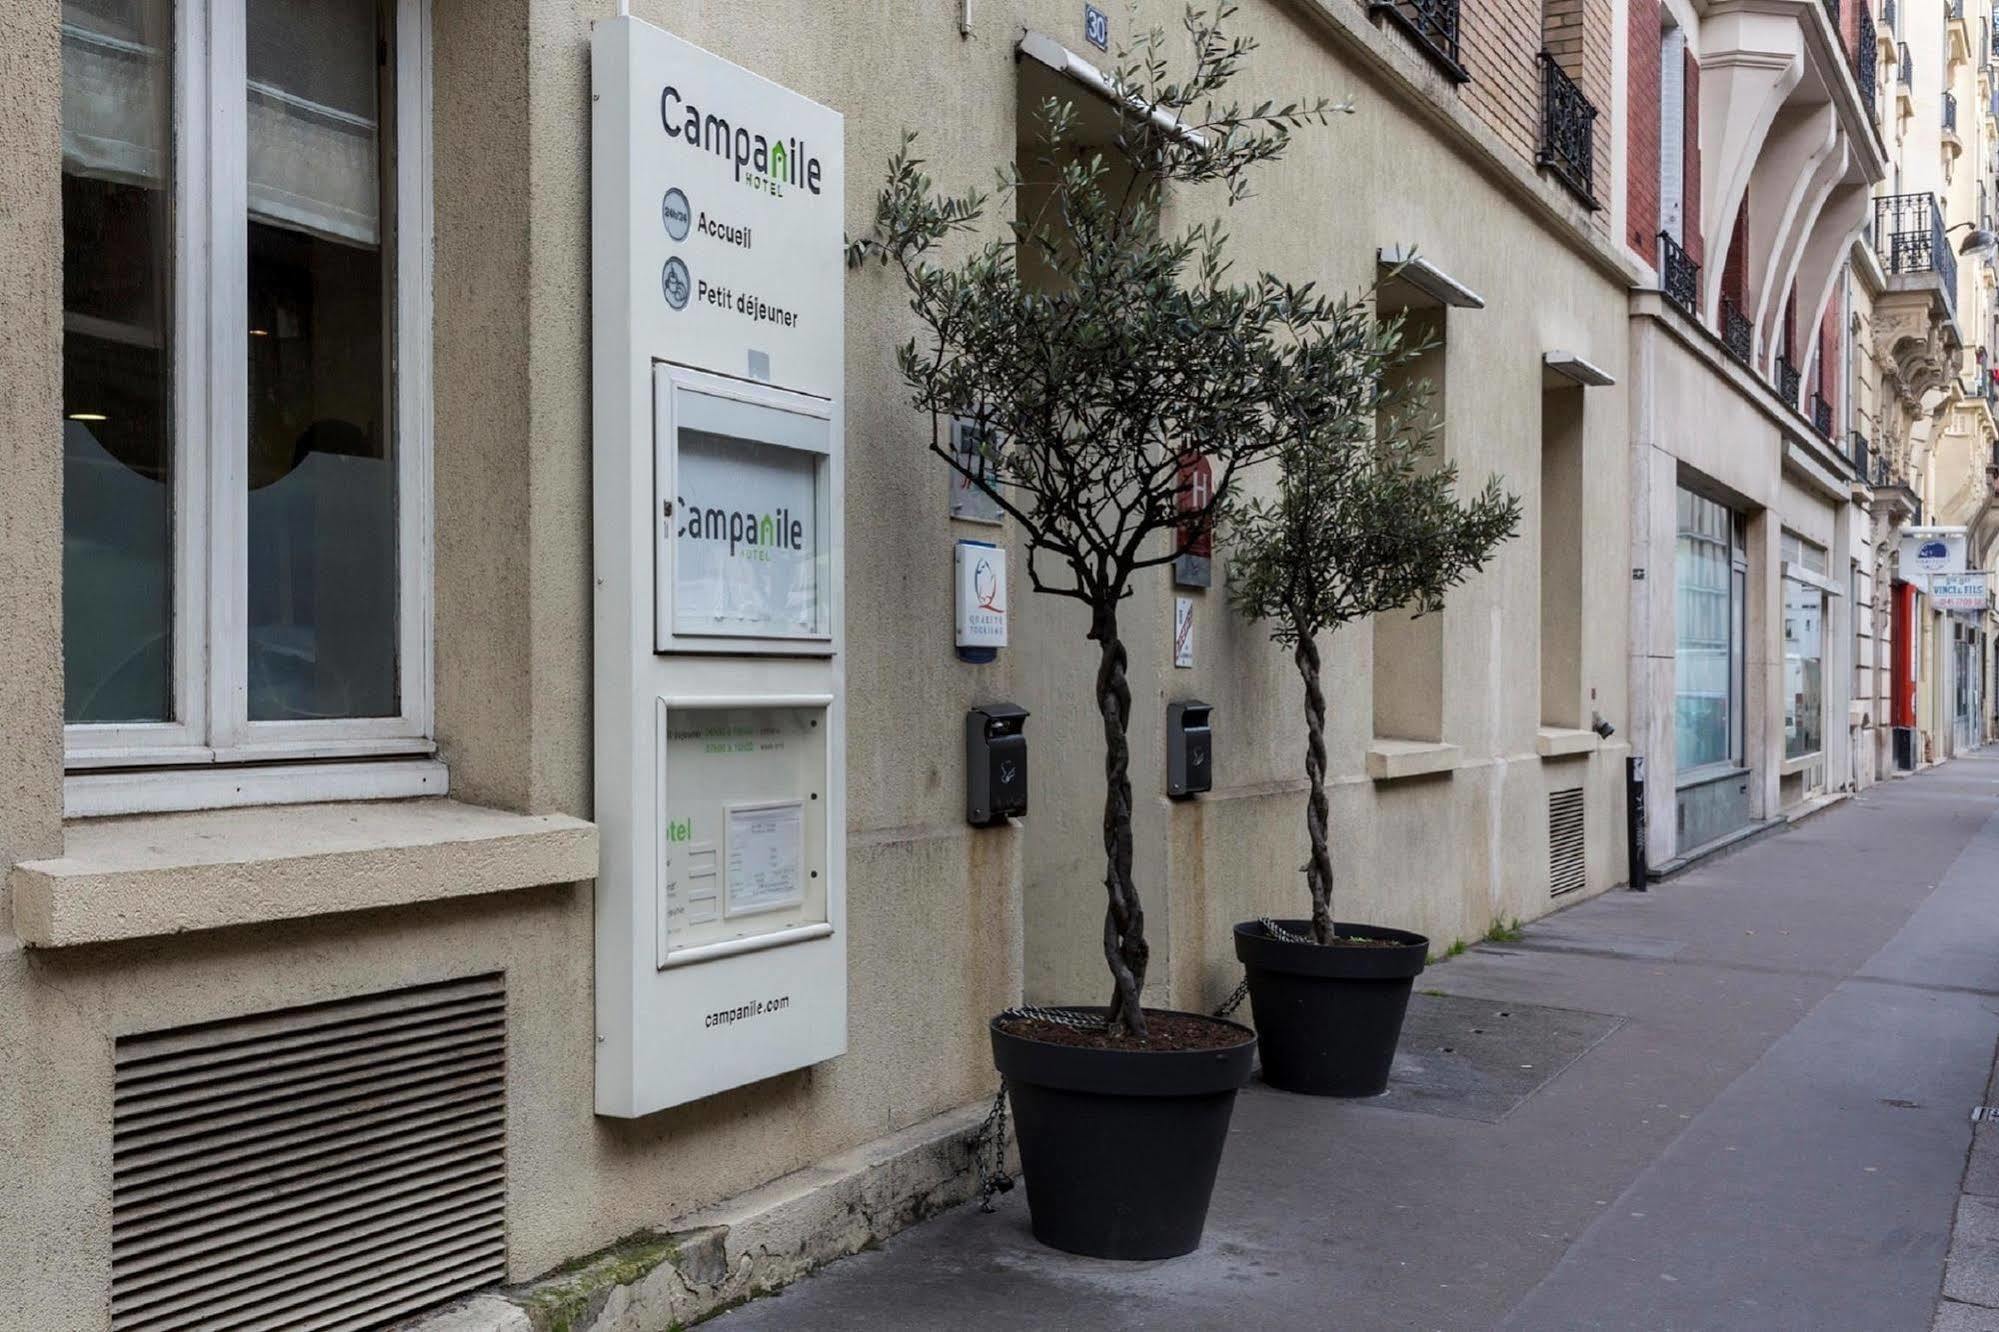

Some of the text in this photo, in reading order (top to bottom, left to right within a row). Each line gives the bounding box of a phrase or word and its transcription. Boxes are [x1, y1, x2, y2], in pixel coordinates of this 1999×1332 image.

[1089, 11, 1105, 43] 30
[660, 85, 822, 195] Campanile
[745, 172, 783, 198] HOTEL
[697, 211, 751, 249] Accueil
[698, 280, 798, 328] Petit déjeuner
[704, 996, 790, 1028] campanile.com
